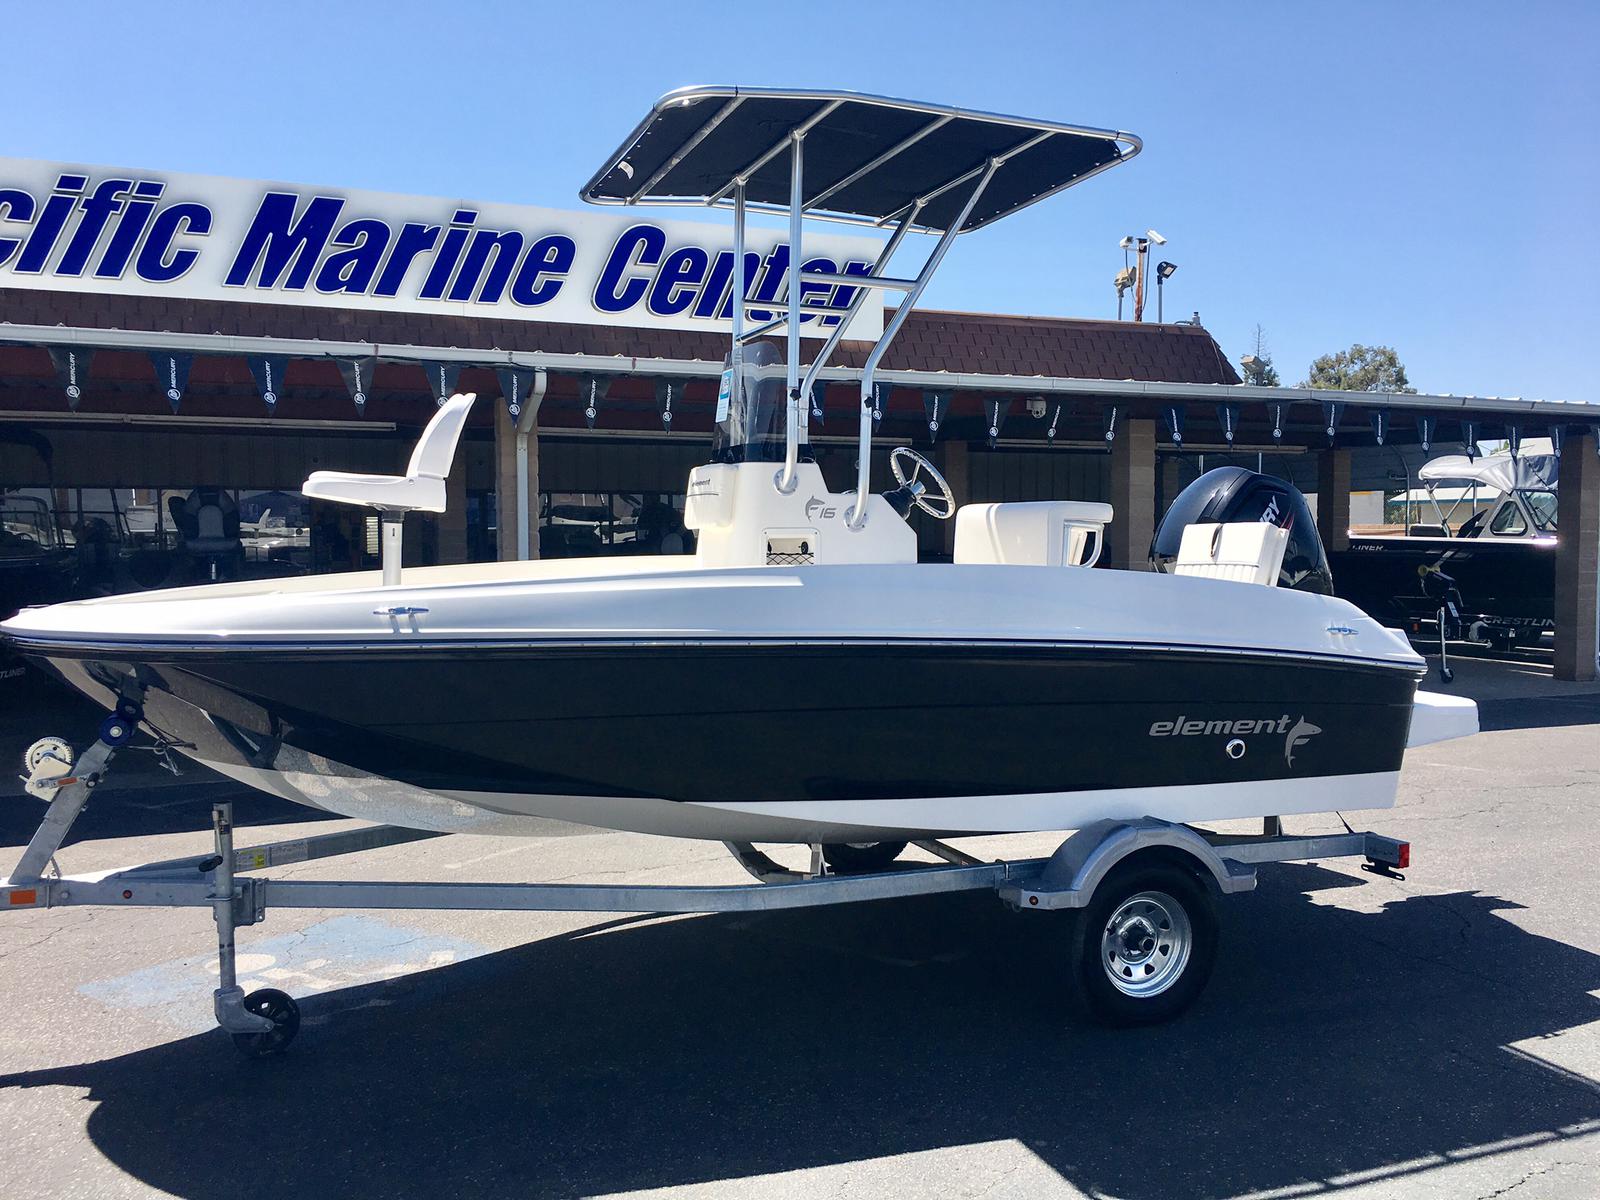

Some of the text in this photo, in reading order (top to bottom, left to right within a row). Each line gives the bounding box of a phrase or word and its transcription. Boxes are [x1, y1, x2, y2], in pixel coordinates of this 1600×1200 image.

[222, 191, 577, 308] Marine
[591, 223, 876, 328] Center
[69, 352, 77, 385] MERCURY
[265, 360, 273, 392] MERCURY
[353, 361, 362, 393] MERCURY
[1149, 714, 1292, 737] element
